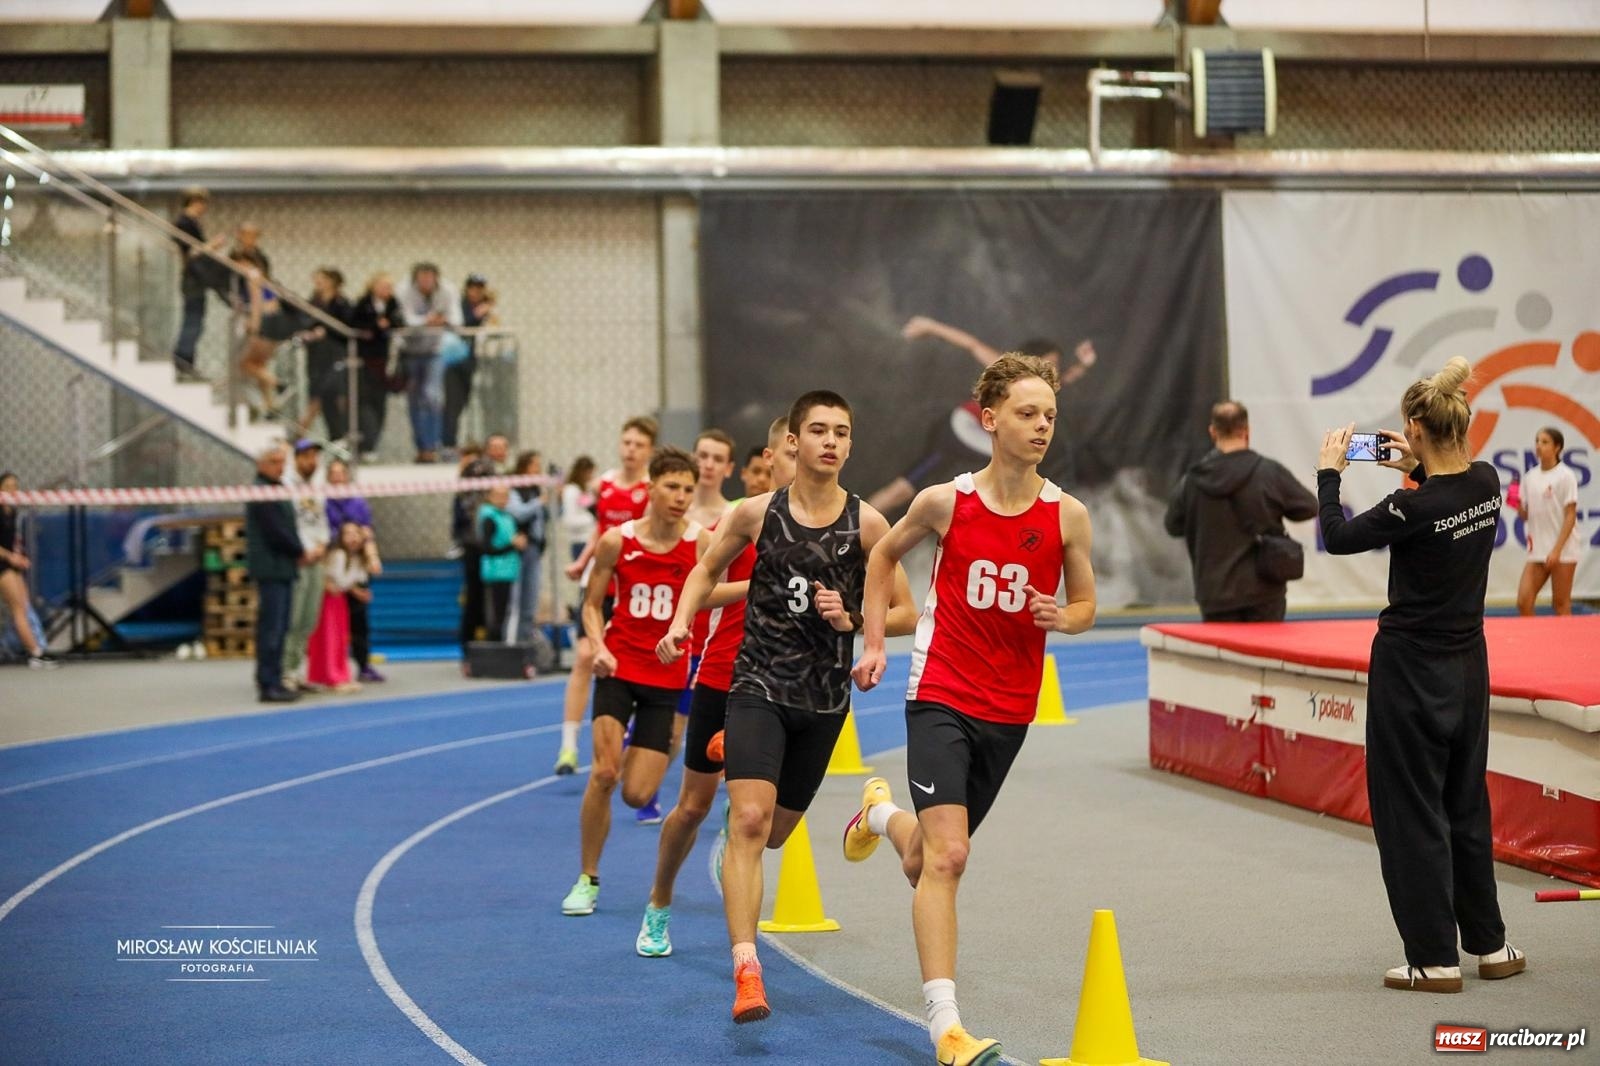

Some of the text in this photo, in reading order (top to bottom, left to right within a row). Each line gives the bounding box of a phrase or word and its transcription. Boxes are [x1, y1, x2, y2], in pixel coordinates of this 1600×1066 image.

[1434, 511, 1467, 533] ZSOMS
[1453, 524, 1474, 540] SZKOŁA
[1474, 522, 1479, 531] Z
[629, 583, 673, 621] 88
[787, 576, 809, 614] 3
[966, 559, 1029, 613] 63
[1319, 694, 1355, 722] polanik
